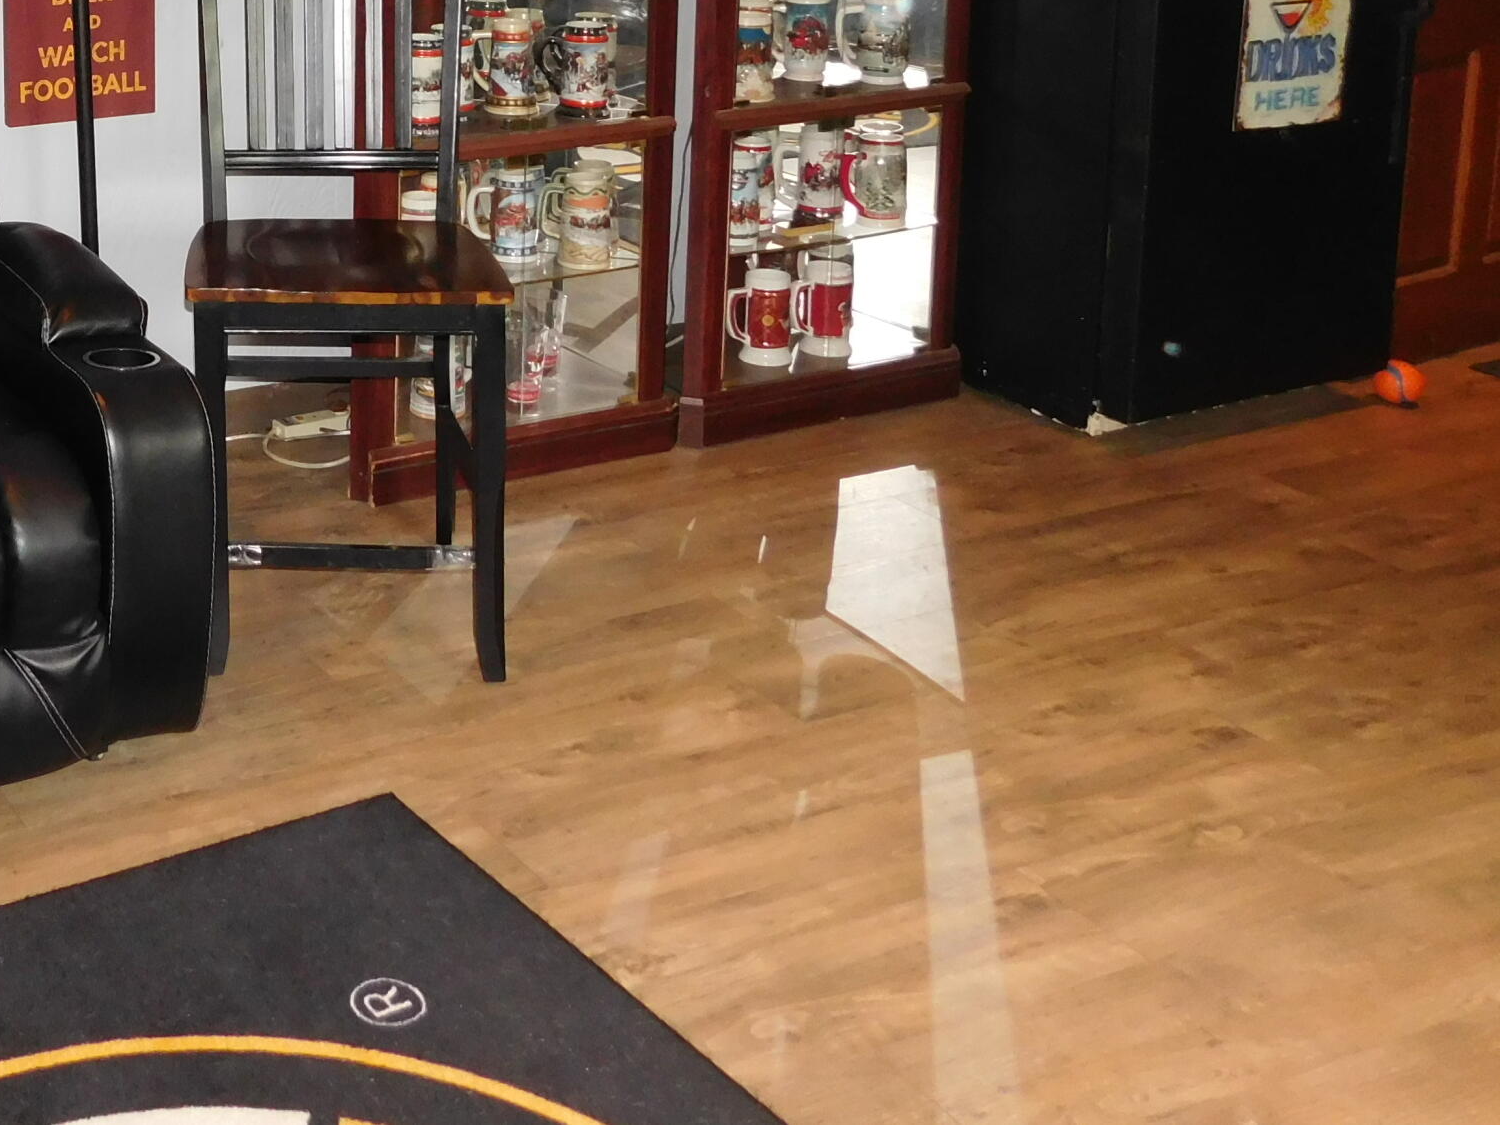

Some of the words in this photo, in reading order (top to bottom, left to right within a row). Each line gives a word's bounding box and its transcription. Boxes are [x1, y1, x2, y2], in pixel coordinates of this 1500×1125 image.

[62, 14, 101, 32] AD
[38, 39, 126, 68] WACH
[1245, 32, 1337, 83] DRINKS
[19, 70, 147, 104] FOOBALL
[1254, 84, 1320, 112] HERE
